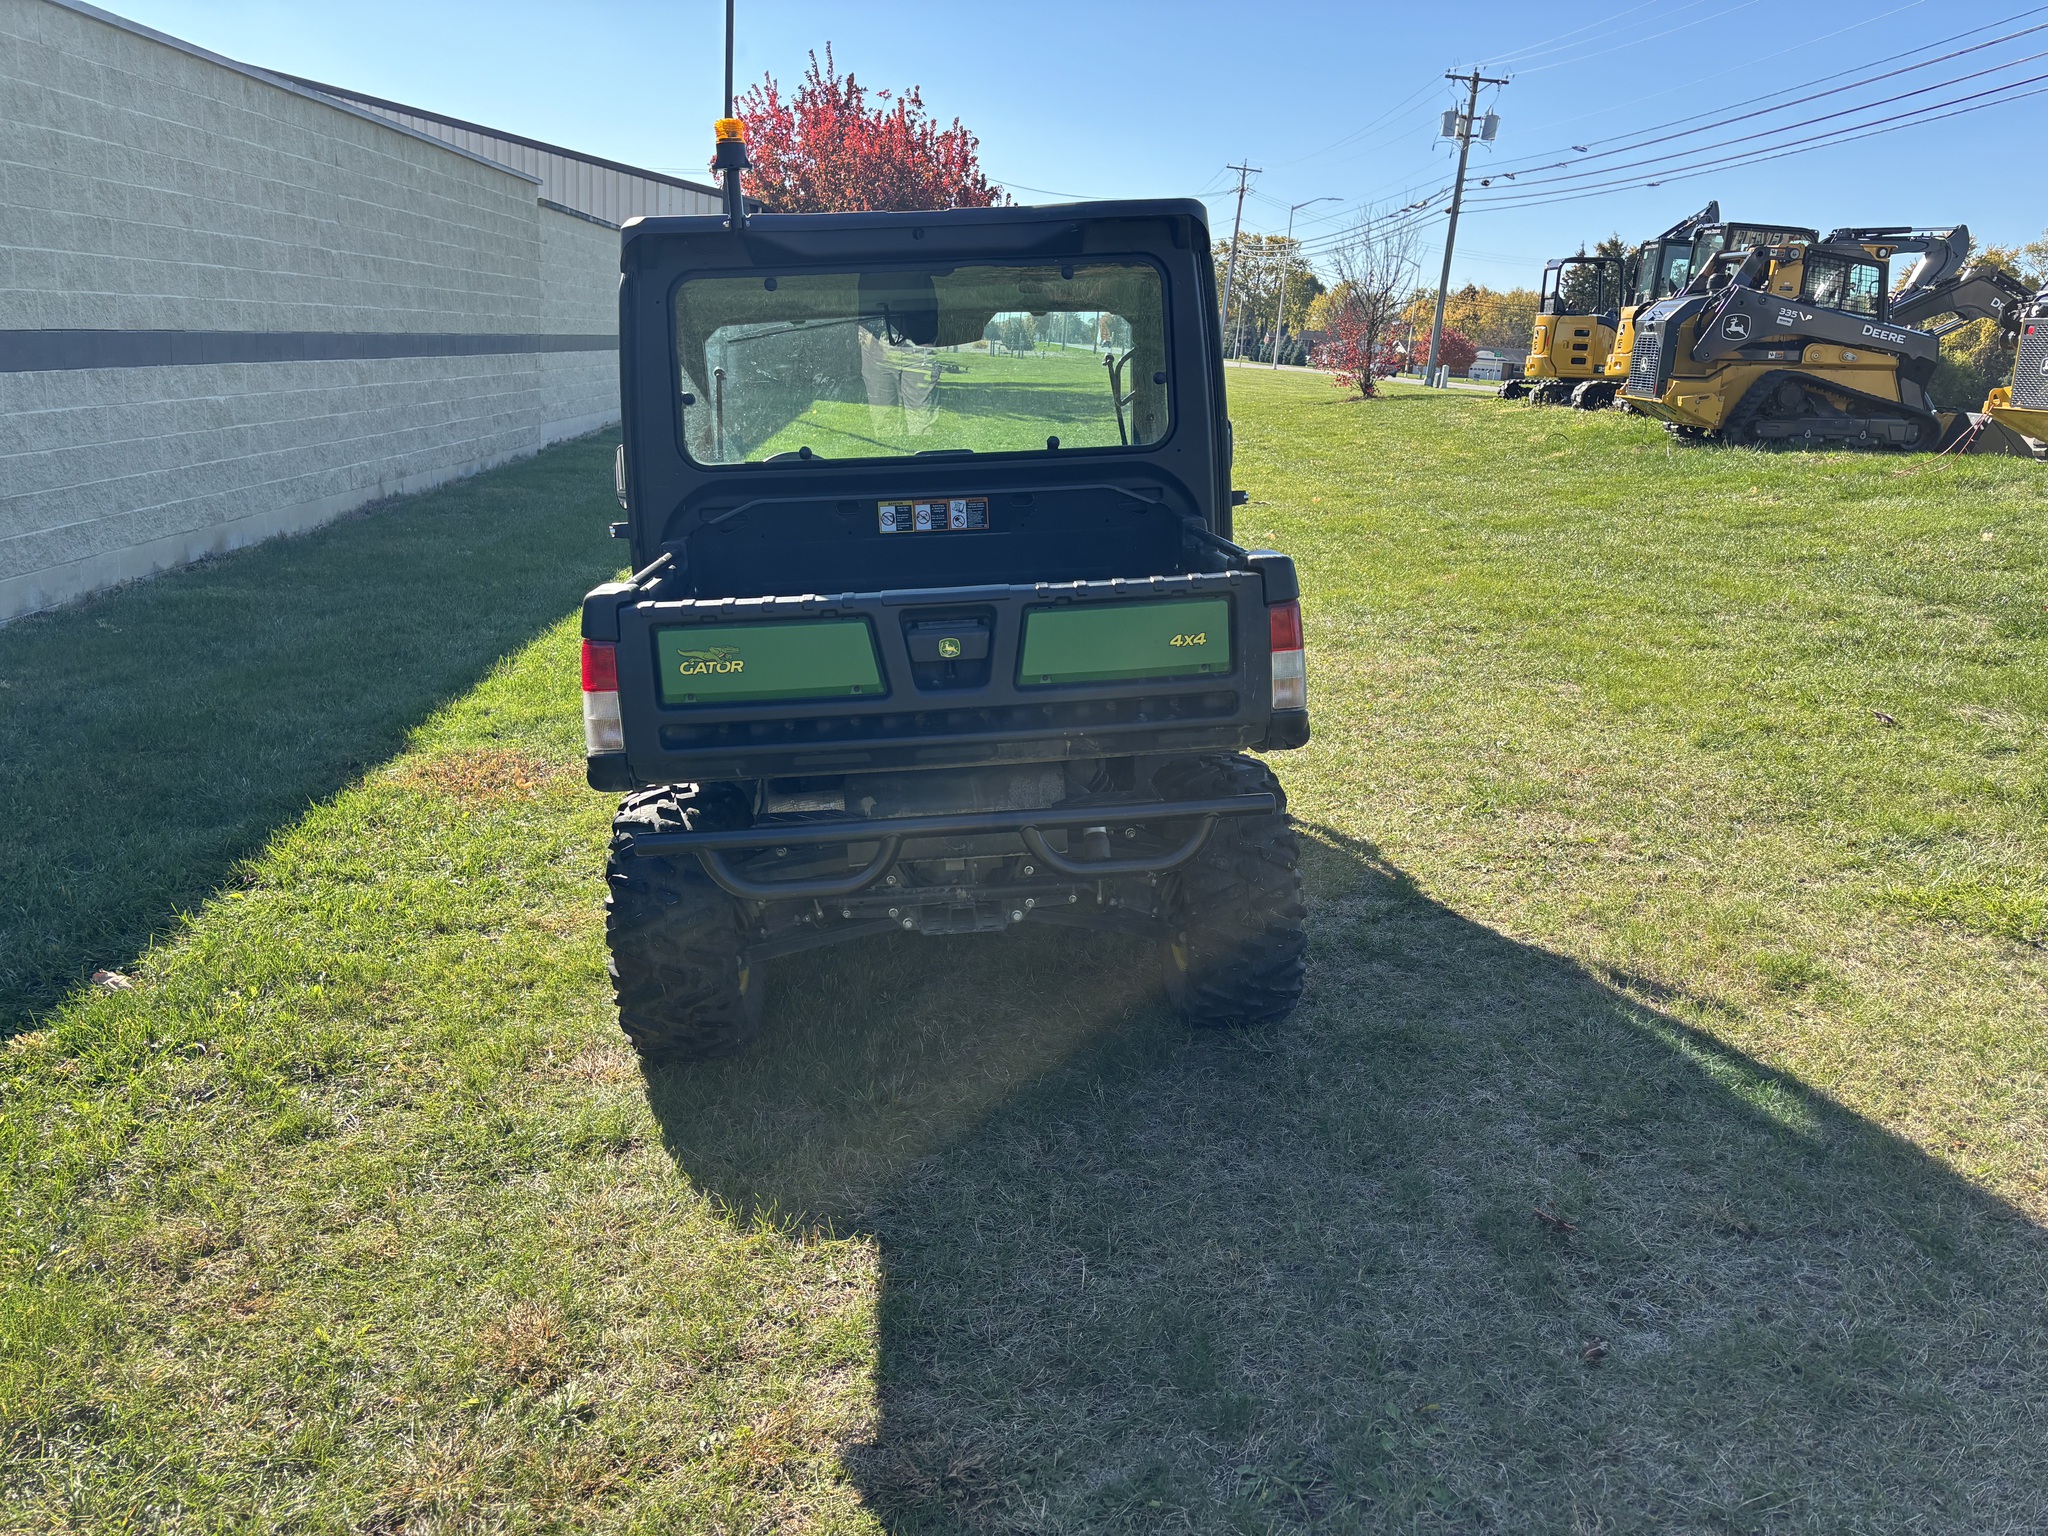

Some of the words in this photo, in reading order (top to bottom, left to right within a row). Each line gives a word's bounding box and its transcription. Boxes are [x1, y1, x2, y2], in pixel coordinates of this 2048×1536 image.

[1779, 307, 1798, 318] 335
[1862, 324, 1906, 344] DEERE
[679, 660, 744, 675] GATOR
